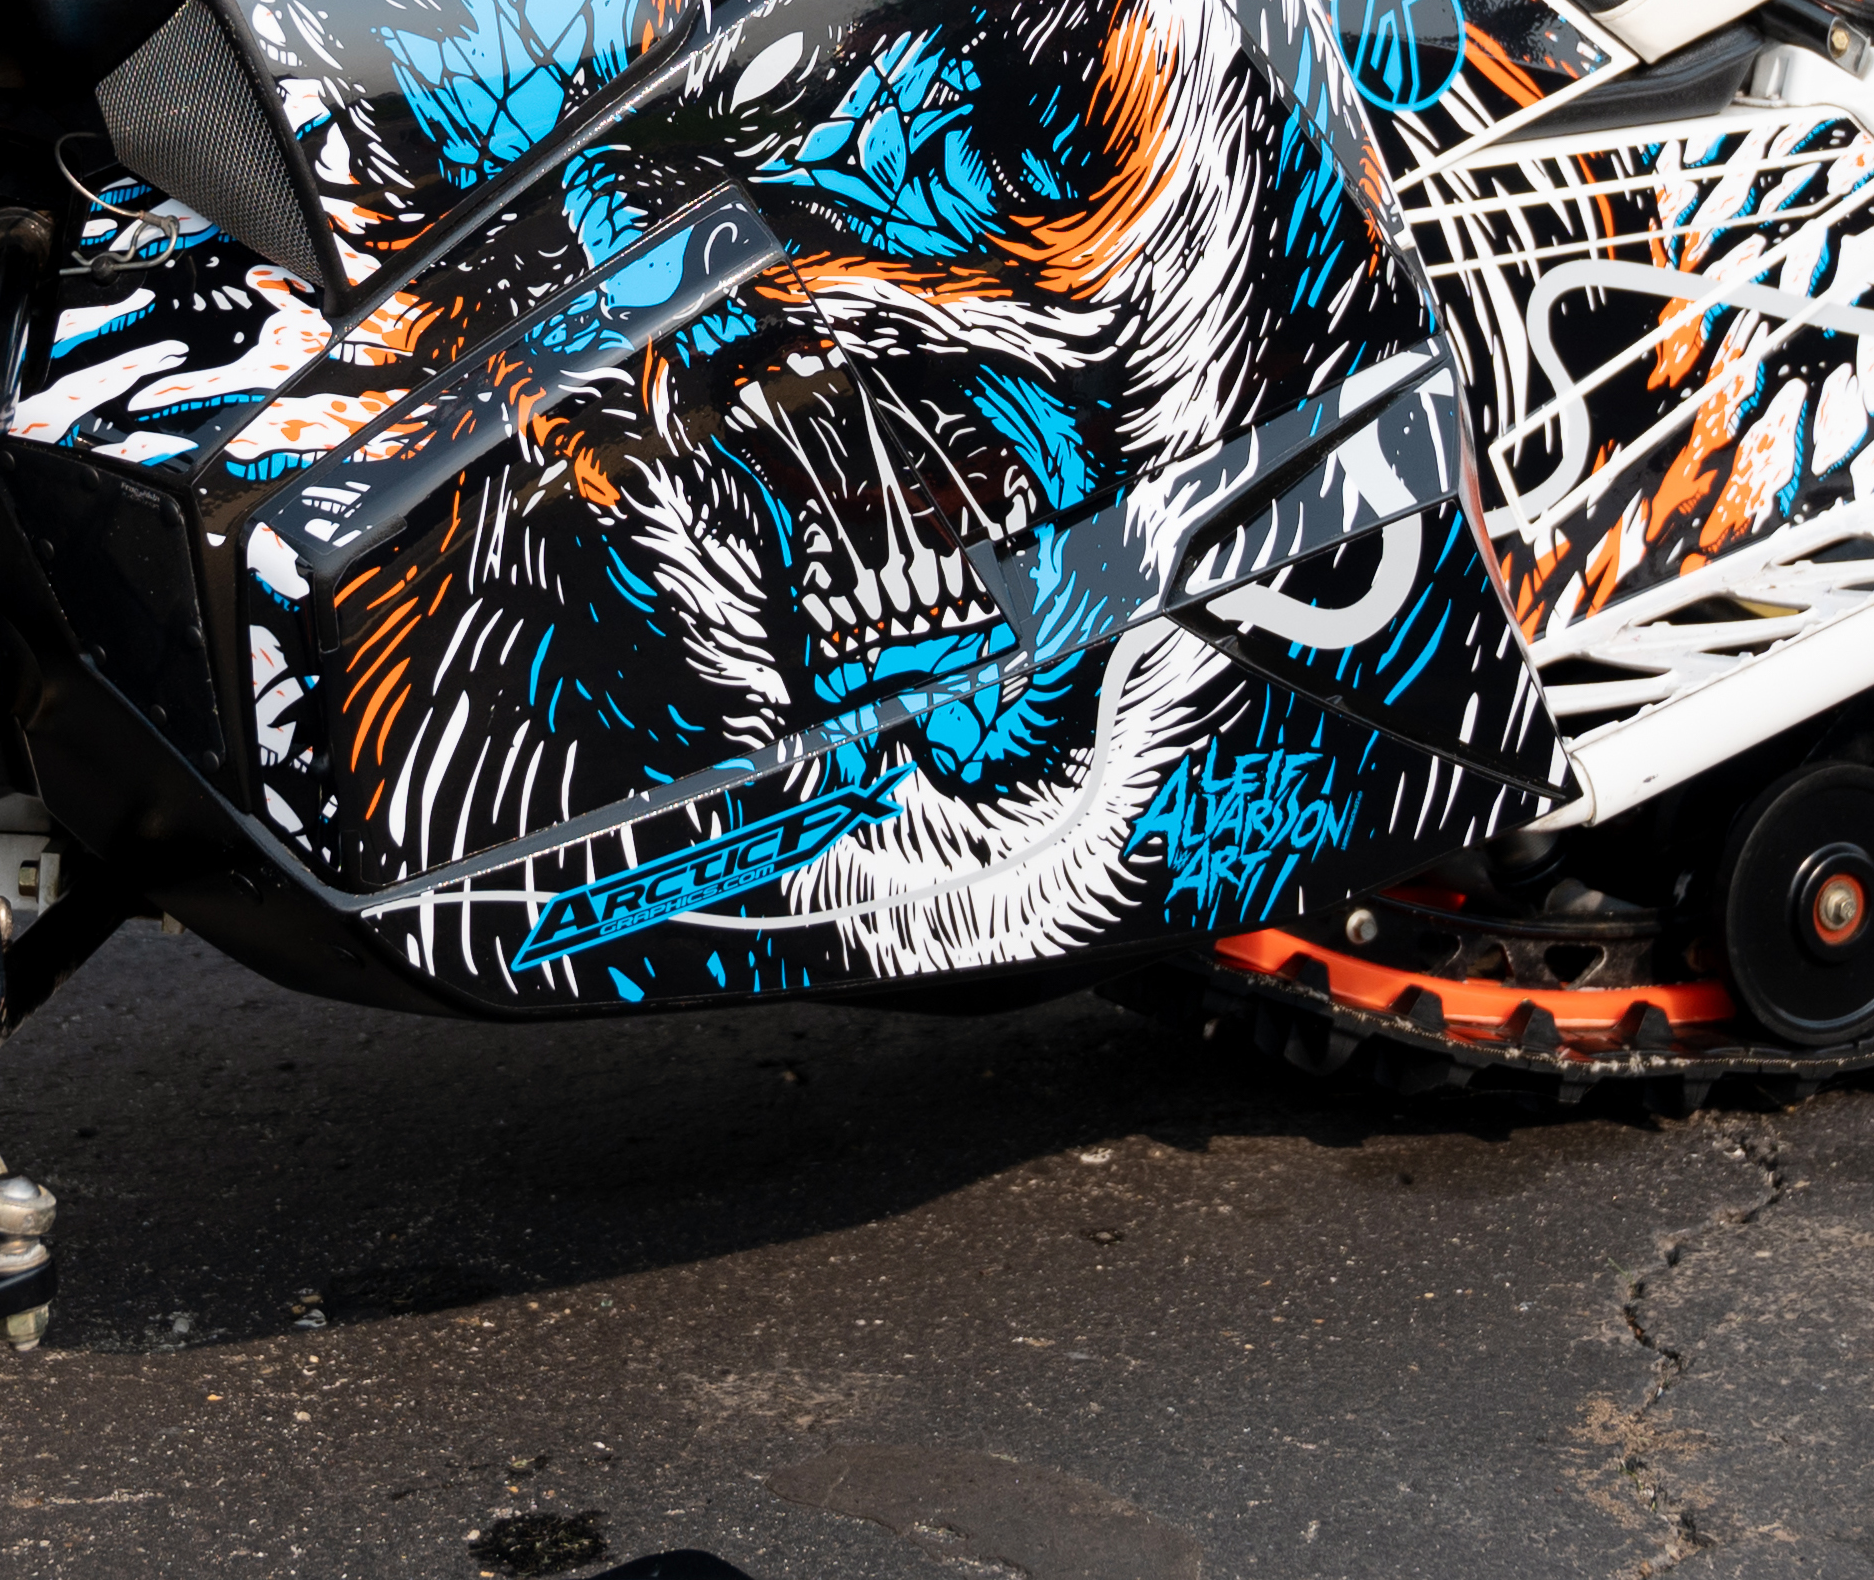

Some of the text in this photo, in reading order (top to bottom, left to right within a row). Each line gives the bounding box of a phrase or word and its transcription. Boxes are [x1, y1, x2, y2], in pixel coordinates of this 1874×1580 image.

[1200, 736, 1324, 801] LEIF
[599, 863, 775, 936] GRAPHICS.COM
[1164, 839, 1272, 911] ART
